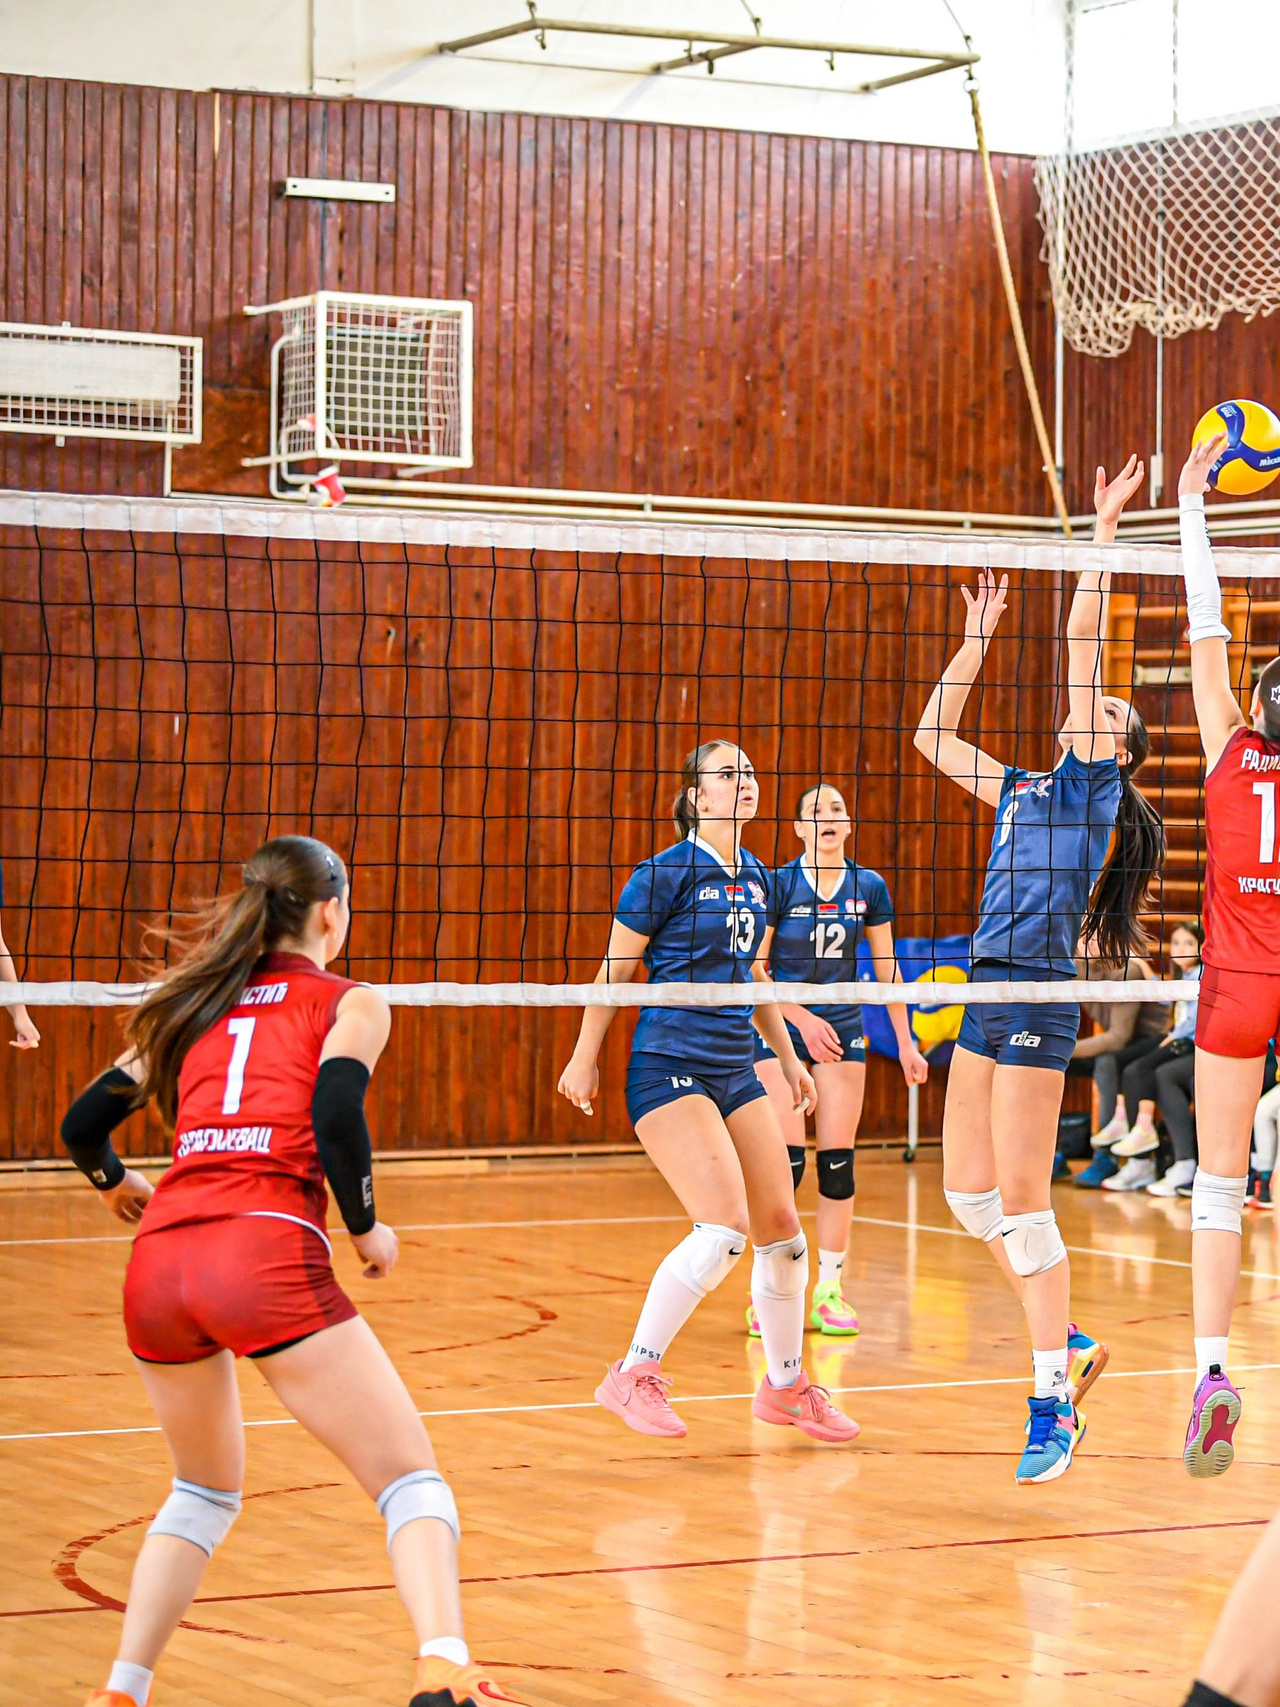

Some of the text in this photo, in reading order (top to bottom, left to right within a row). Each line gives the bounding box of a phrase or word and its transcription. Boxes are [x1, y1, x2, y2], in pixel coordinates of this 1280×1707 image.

[726, 906, 755, 953] 13
[809, 922, 847, 959] 12
[221, 1016, 256, 1115] 1
